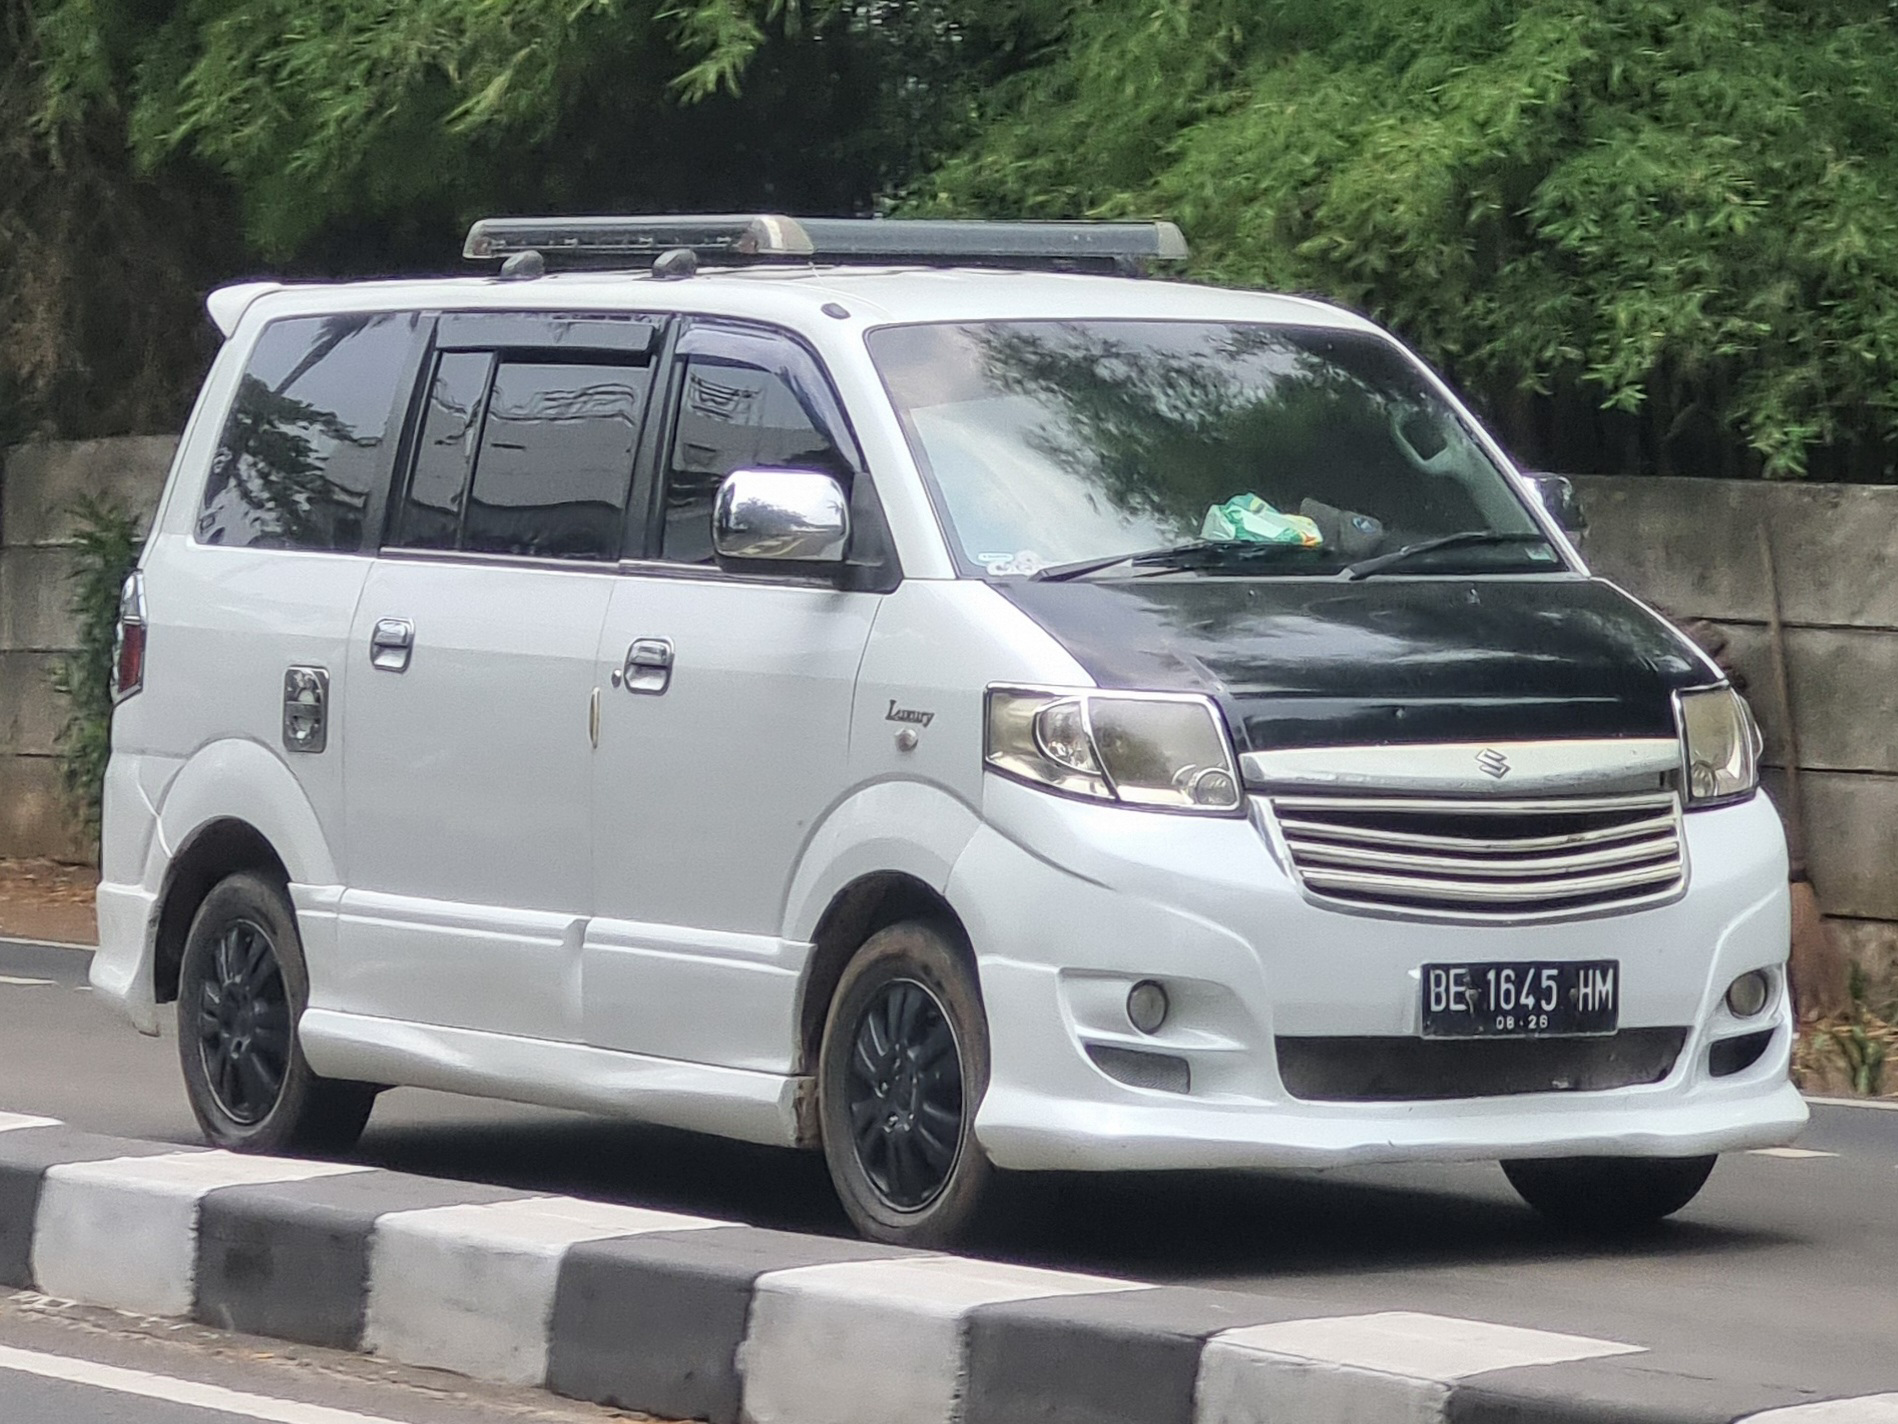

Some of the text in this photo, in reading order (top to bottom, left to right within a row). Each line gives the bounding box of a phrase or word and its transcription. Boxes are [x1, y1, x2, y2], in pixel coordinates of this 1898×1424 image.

[1429, 967, 1614, 1012] BE 1645 HM
